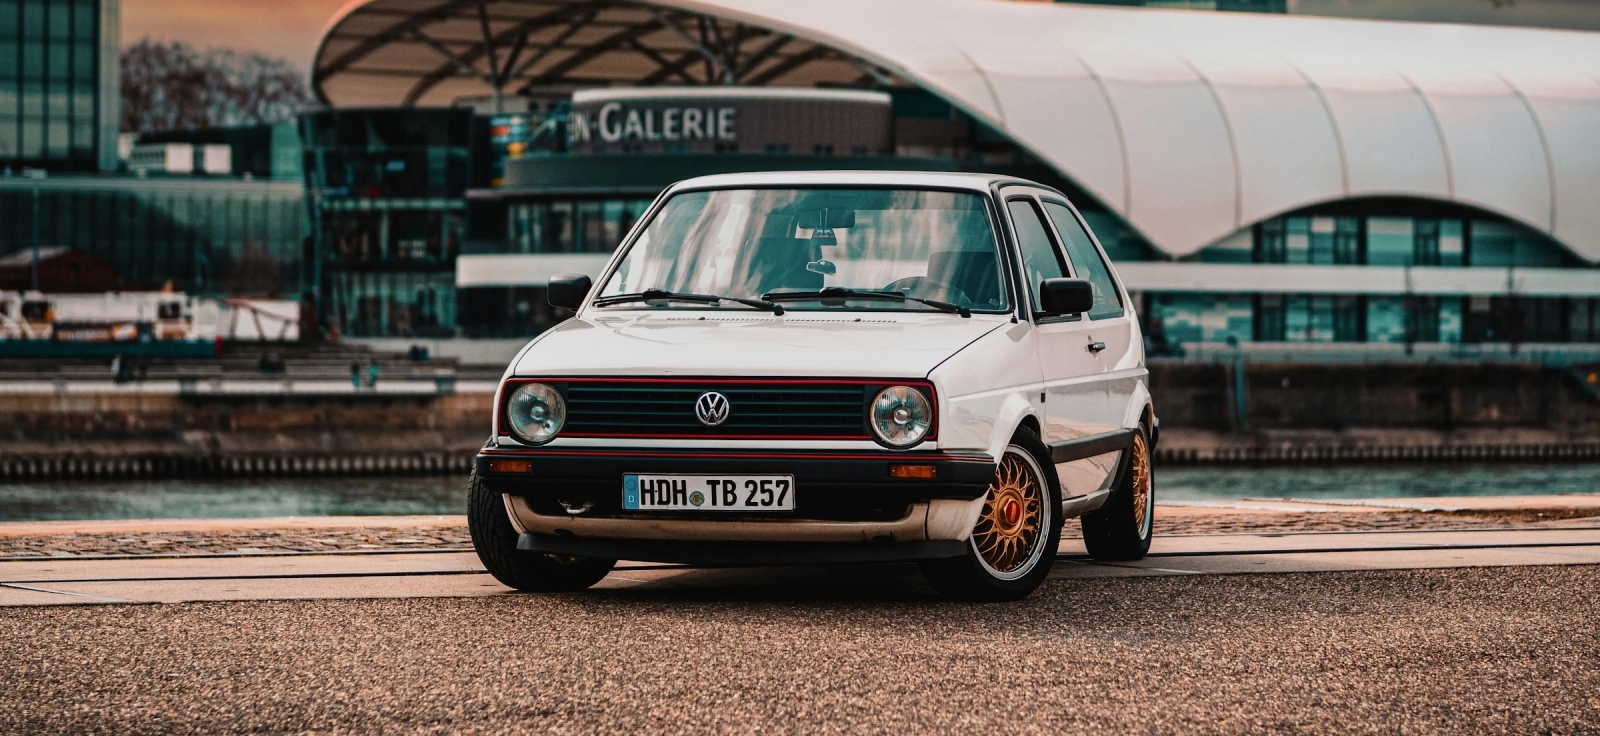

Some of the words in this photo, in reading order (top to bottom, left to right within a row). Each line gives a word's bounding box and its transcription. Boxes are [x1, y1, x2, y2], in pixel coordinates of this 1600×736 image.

[628, 495, 635, 503] D
[640, 479, 687, 505] HDH
[706, 480, 737, 506] TB
[745, 480, 789, 506] 257
